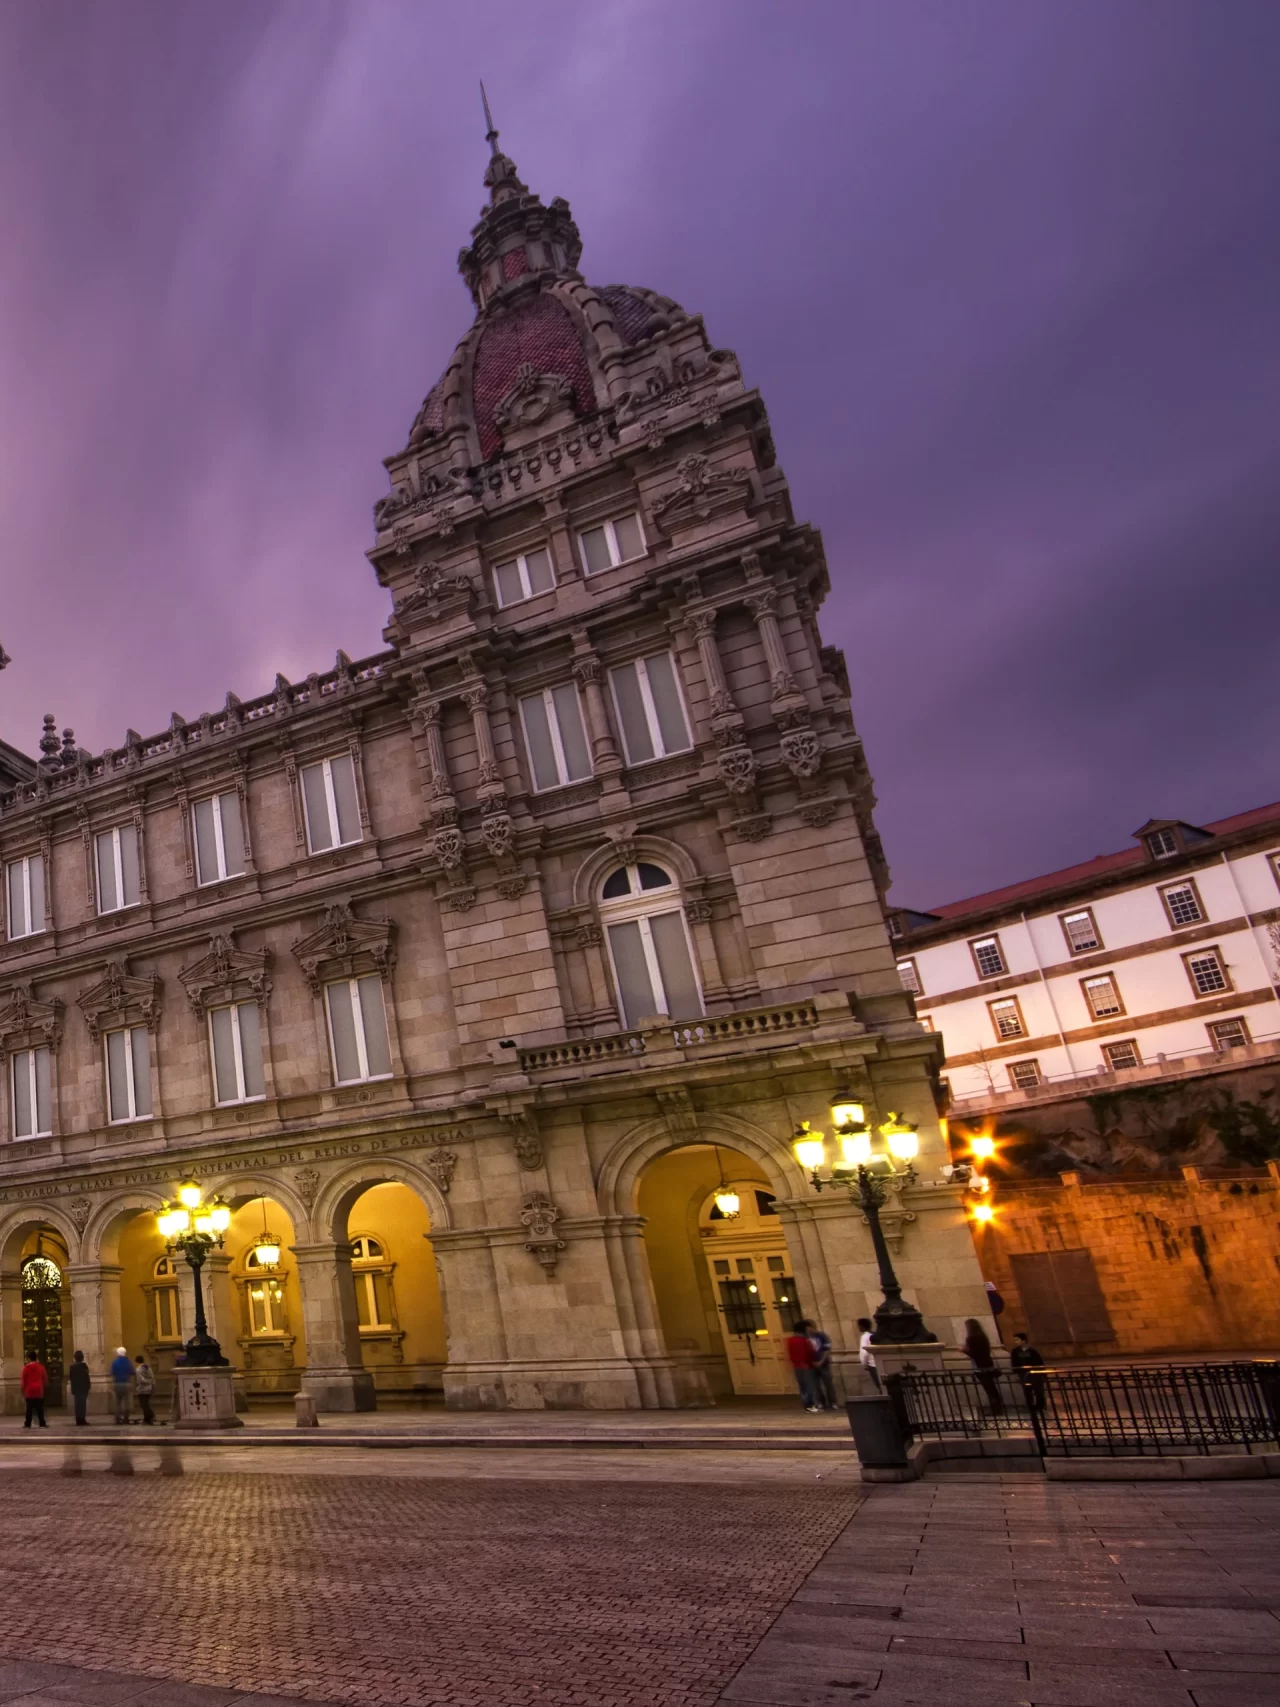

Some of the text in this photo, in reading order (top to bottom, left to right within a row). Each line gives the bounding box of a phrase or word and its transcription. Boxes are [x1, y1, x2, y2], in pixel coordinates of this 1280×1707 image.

[17, 1187, 60, 1198] GVARDA
[67, 1184, 73, 1192] Y
[80, 1178, 114, 1189] LLAVE
[125, 1171, 170, 1184] FVERZA
[177, 1168, 184, 1177] Y
[192, 1157, 269, 1175] ANTEMVRAL
[279, 1151, 304, 1163] DEL
[315, 1143, 360, 1158] REINO
[371, 1141, 388, 1151] DE
[400, 1129, 465, 1146] GALICIA
